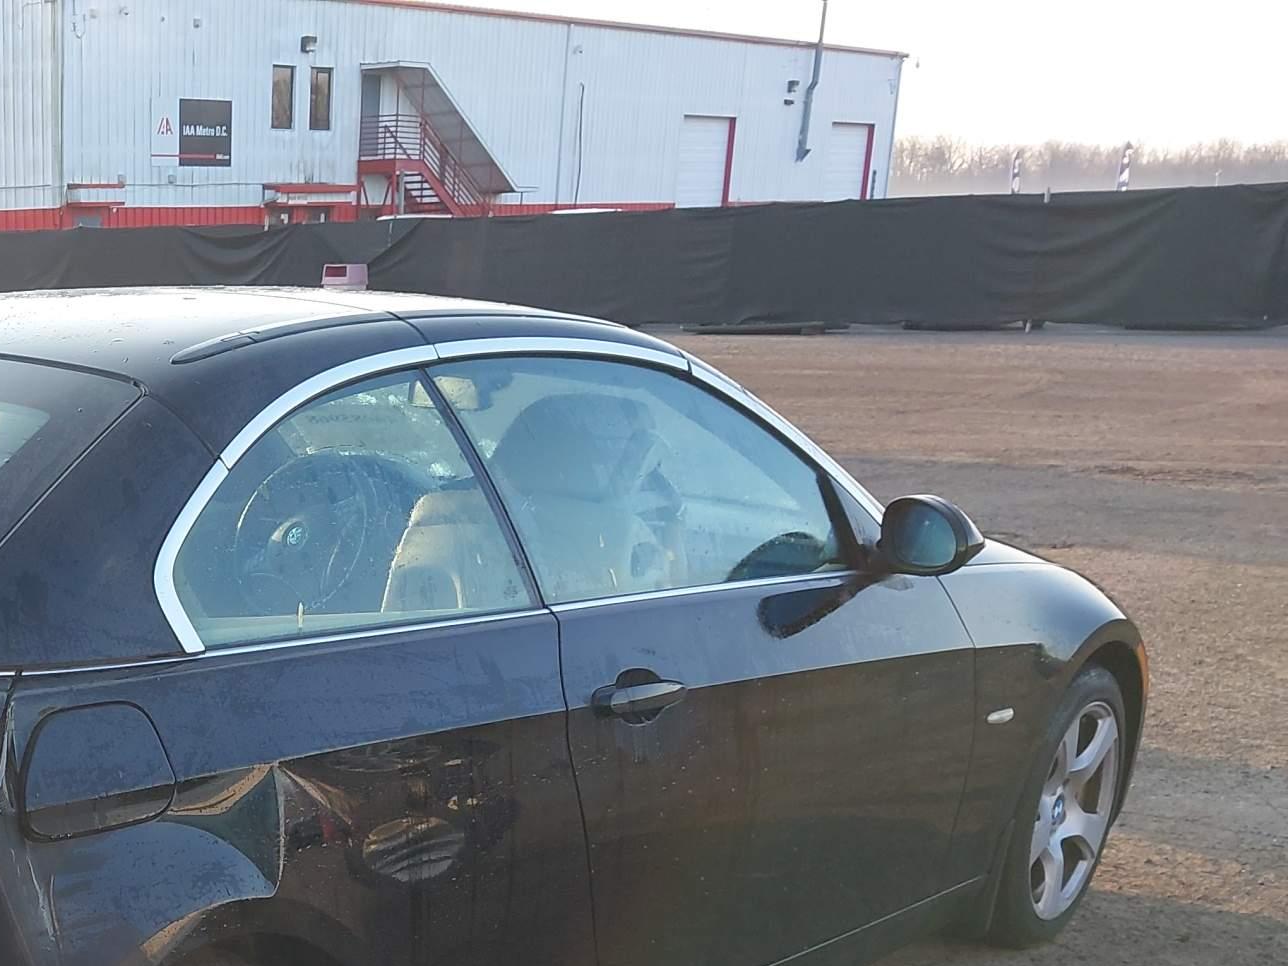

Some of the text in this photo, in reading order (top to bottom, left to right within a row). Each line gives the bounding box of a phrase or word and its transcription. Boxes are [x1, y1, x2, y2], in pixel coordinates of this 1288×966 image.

[183, 125, 228, 136] IAA Metro D.C.
